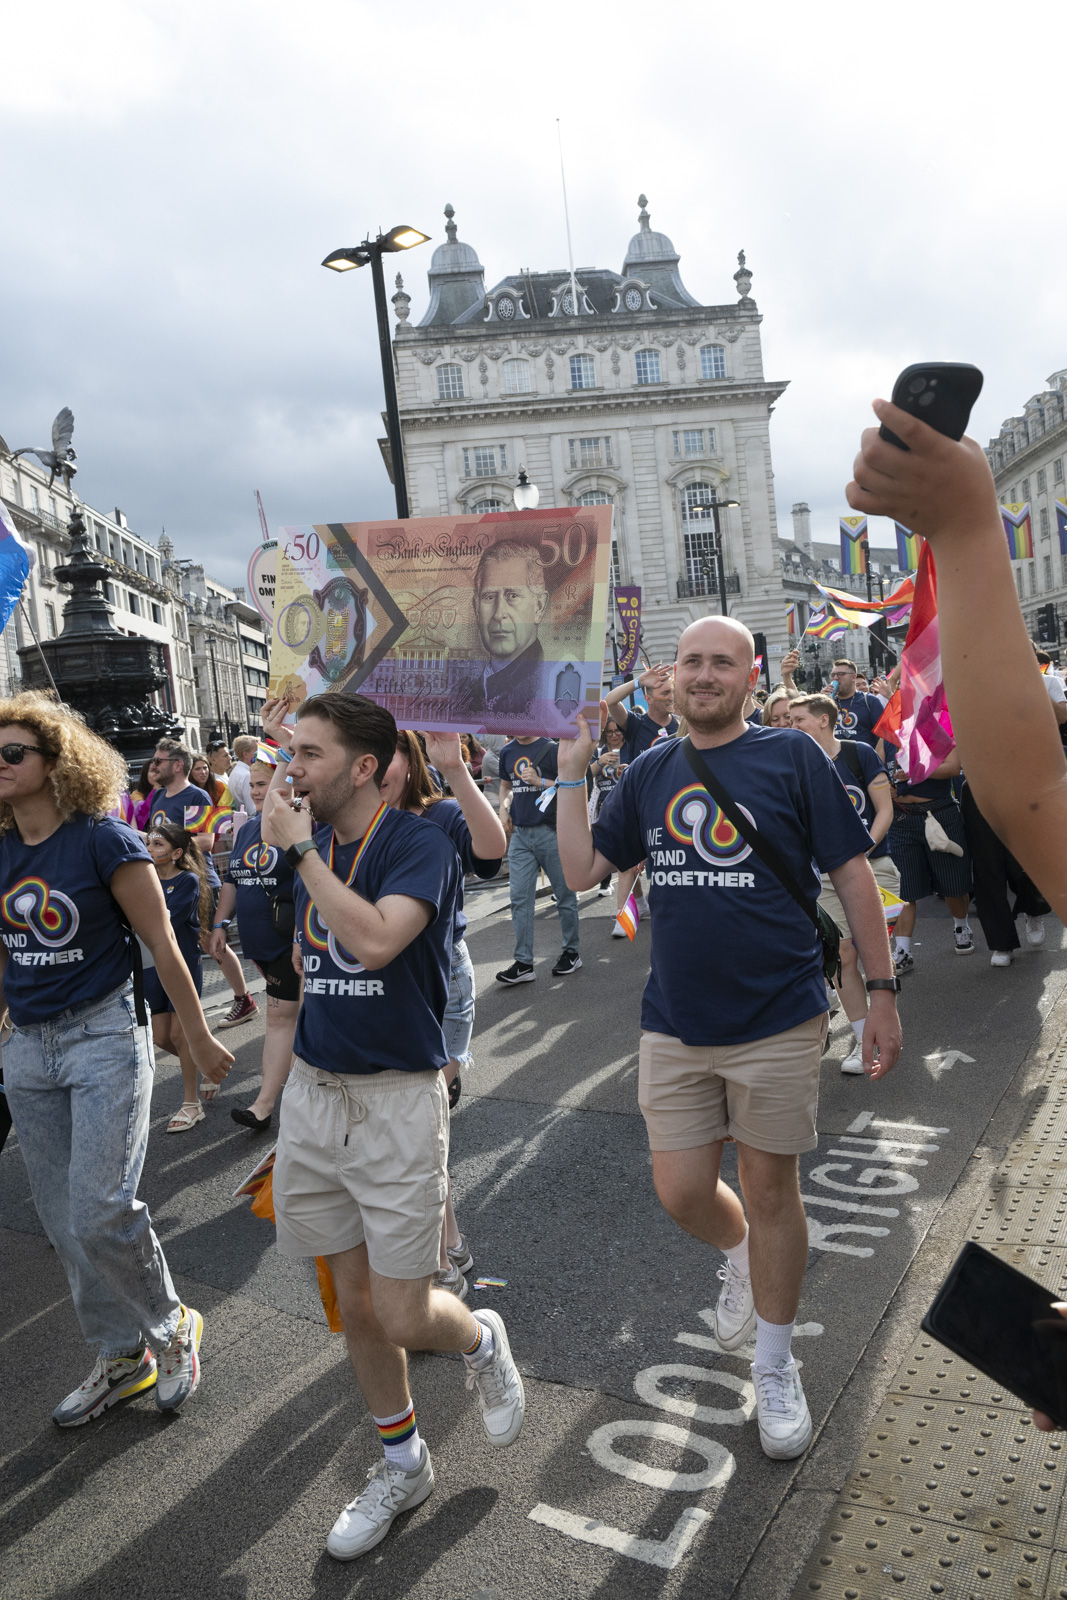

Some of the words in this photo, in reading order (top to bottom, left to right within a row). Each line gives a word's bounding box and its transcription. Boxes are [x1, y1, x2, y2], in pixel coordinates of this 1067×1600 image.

[282, 532, 320, 561] £50
[376, 535, 424, 560] Bank
[435, 533, 489, 563] England
[535, 523, 588, 567] 50
[617, 619, 638, 672] Crossing
[646, 827, 663, 847] WE
[0, 933, 28, 948] AND
[11, 948, 84, 966] GETHER
